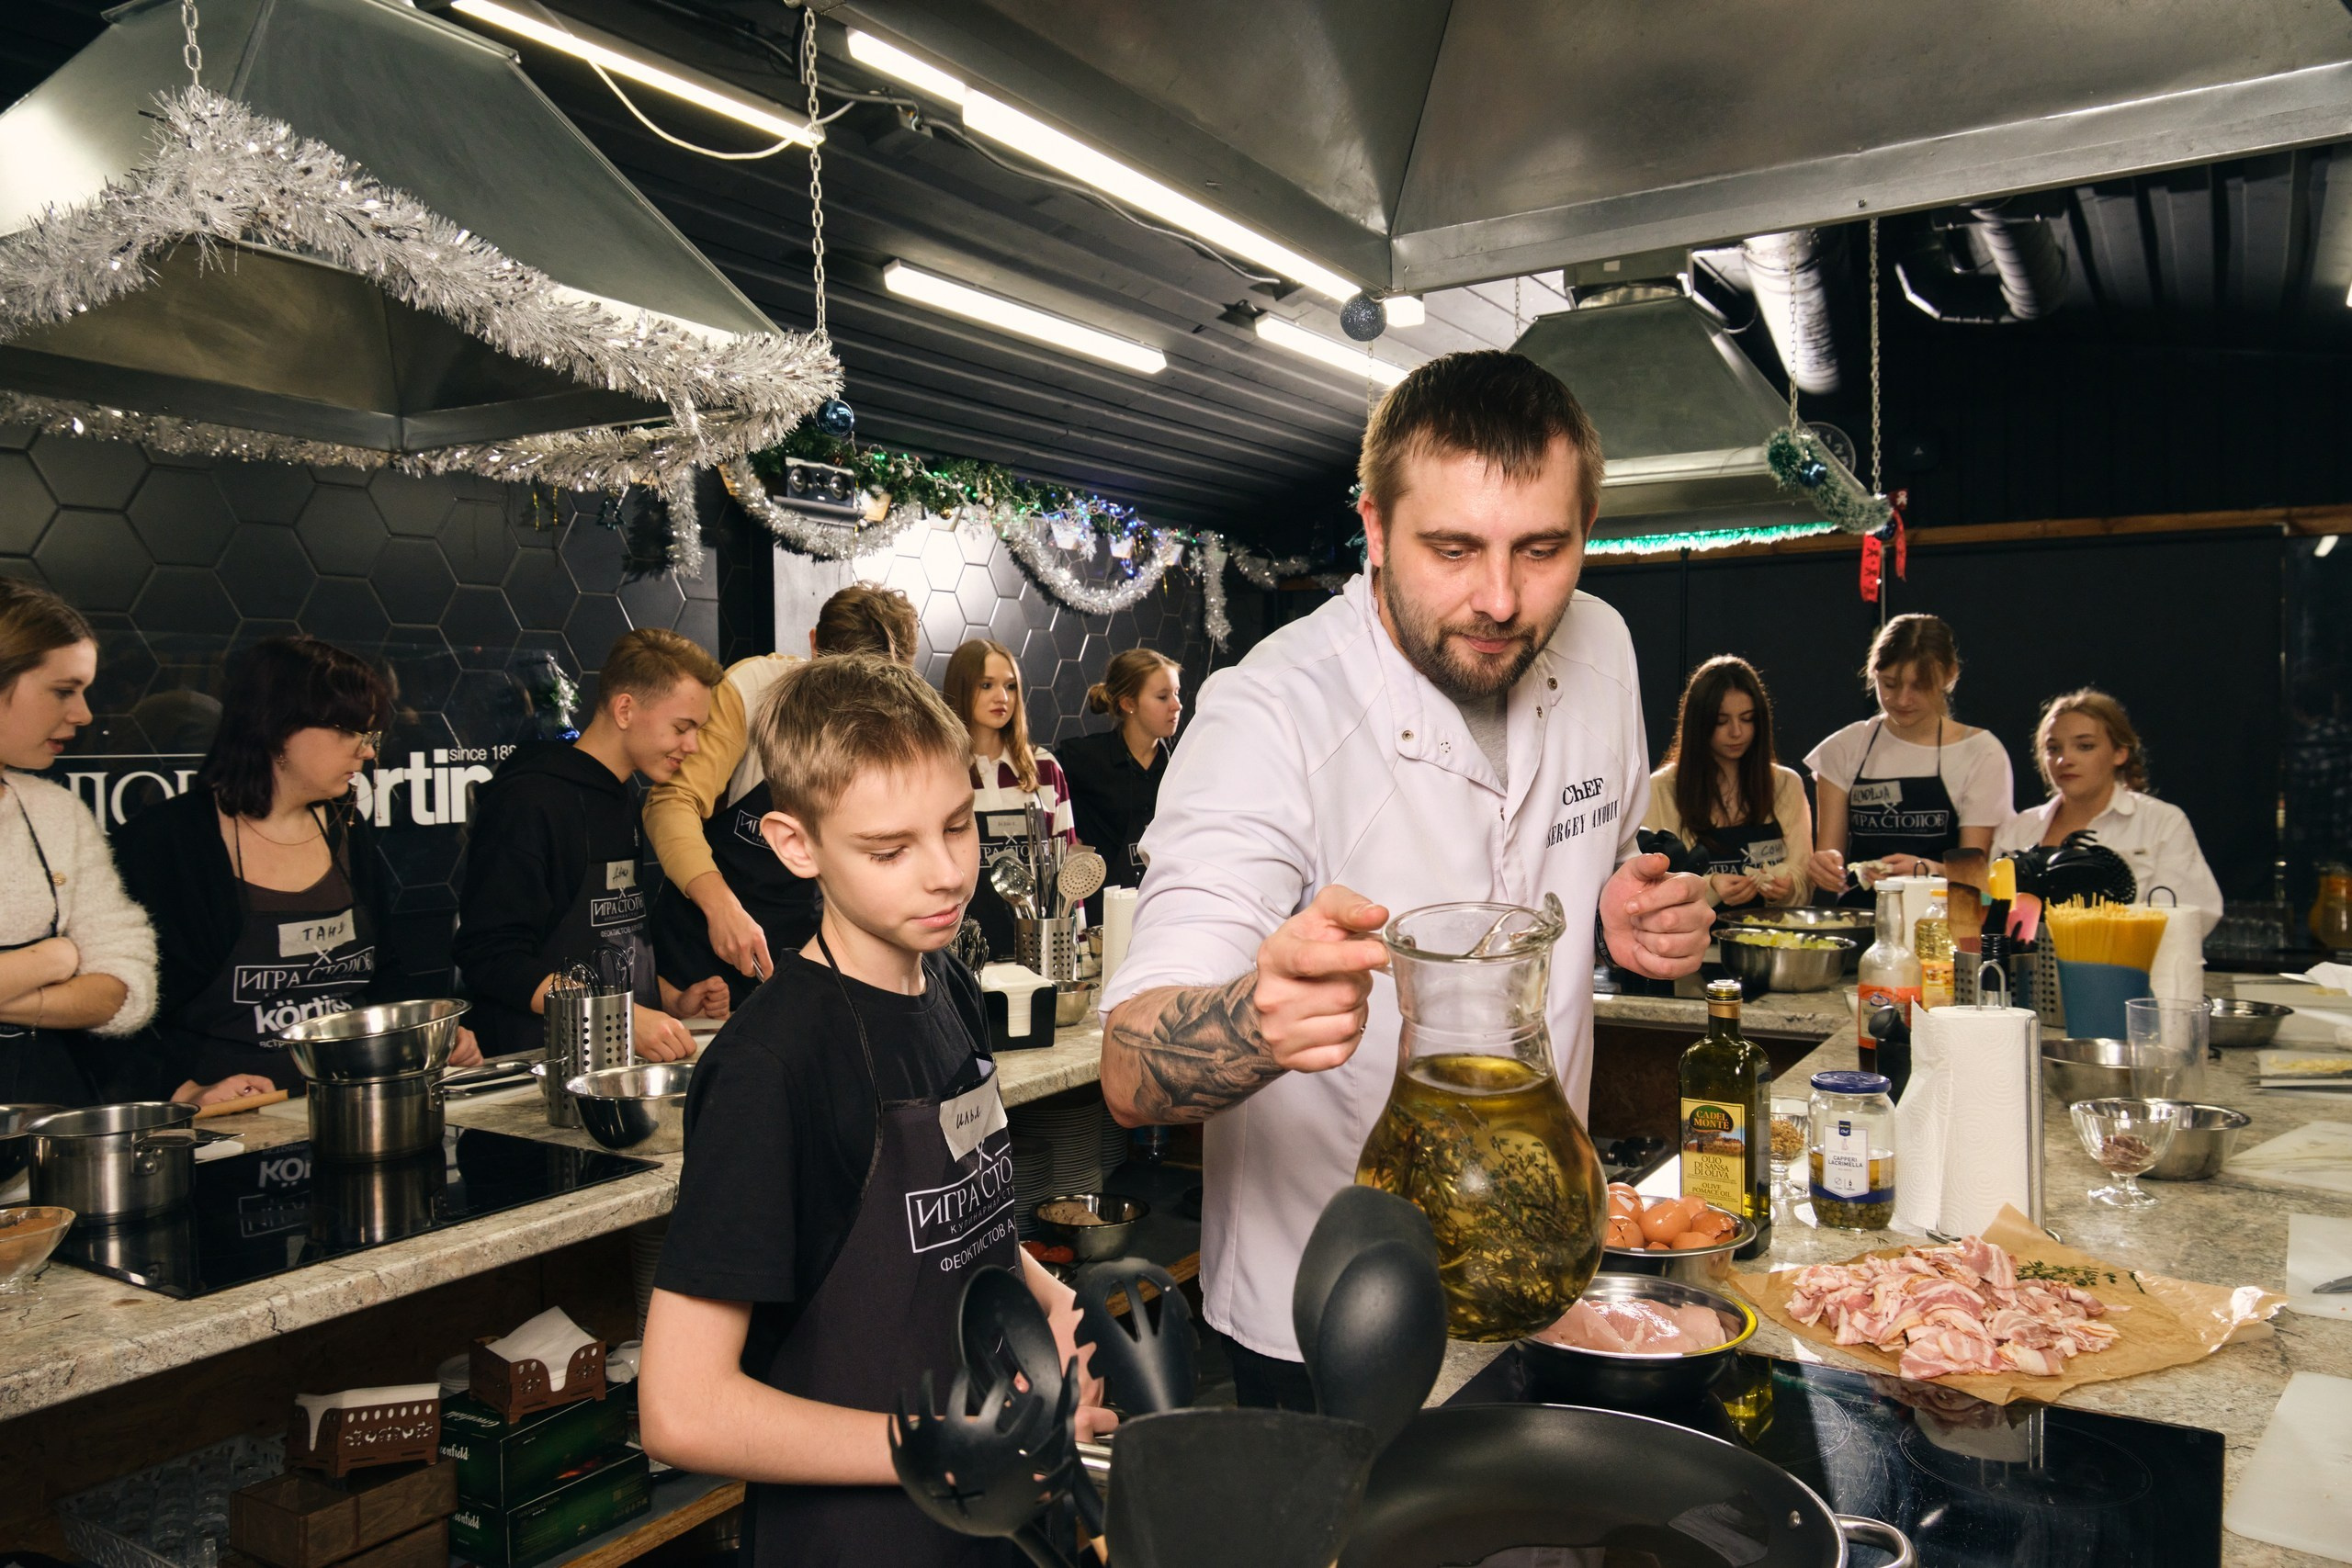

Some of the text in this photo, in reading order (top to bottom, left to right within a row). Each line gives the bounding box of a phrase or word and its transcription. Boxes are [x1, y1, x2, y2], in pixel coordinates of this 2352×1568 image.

[448, 748, 488, 761] since
[1545, 814, 1587, 849] SERGEY
[241, 970, 301, 989] ИГРА
[1693, 1118, 1730, 1131] MONTE
[1701, 1156, 1723, 1165] OLIO
[1827, 1159, 1863, 1168] LACRIMELLA
[1833, 1155, 1858, 1163] CAPPERI
[1694, 1161, 1730, 1173] DI SANSA
[1704, 1168, 1730, 1179] OLIVA
[1691, 1187, 1719, 1196] POMACE
[1702, 1182, 1722, 1190] OLIVE
[915, 1182, 980, 1230] ИГРА
[950, 1195, 1001, 1235] КУЛИНАРНАЯ
[939, 1223, 1006, 1272] ФЕОКТИСТОВ
